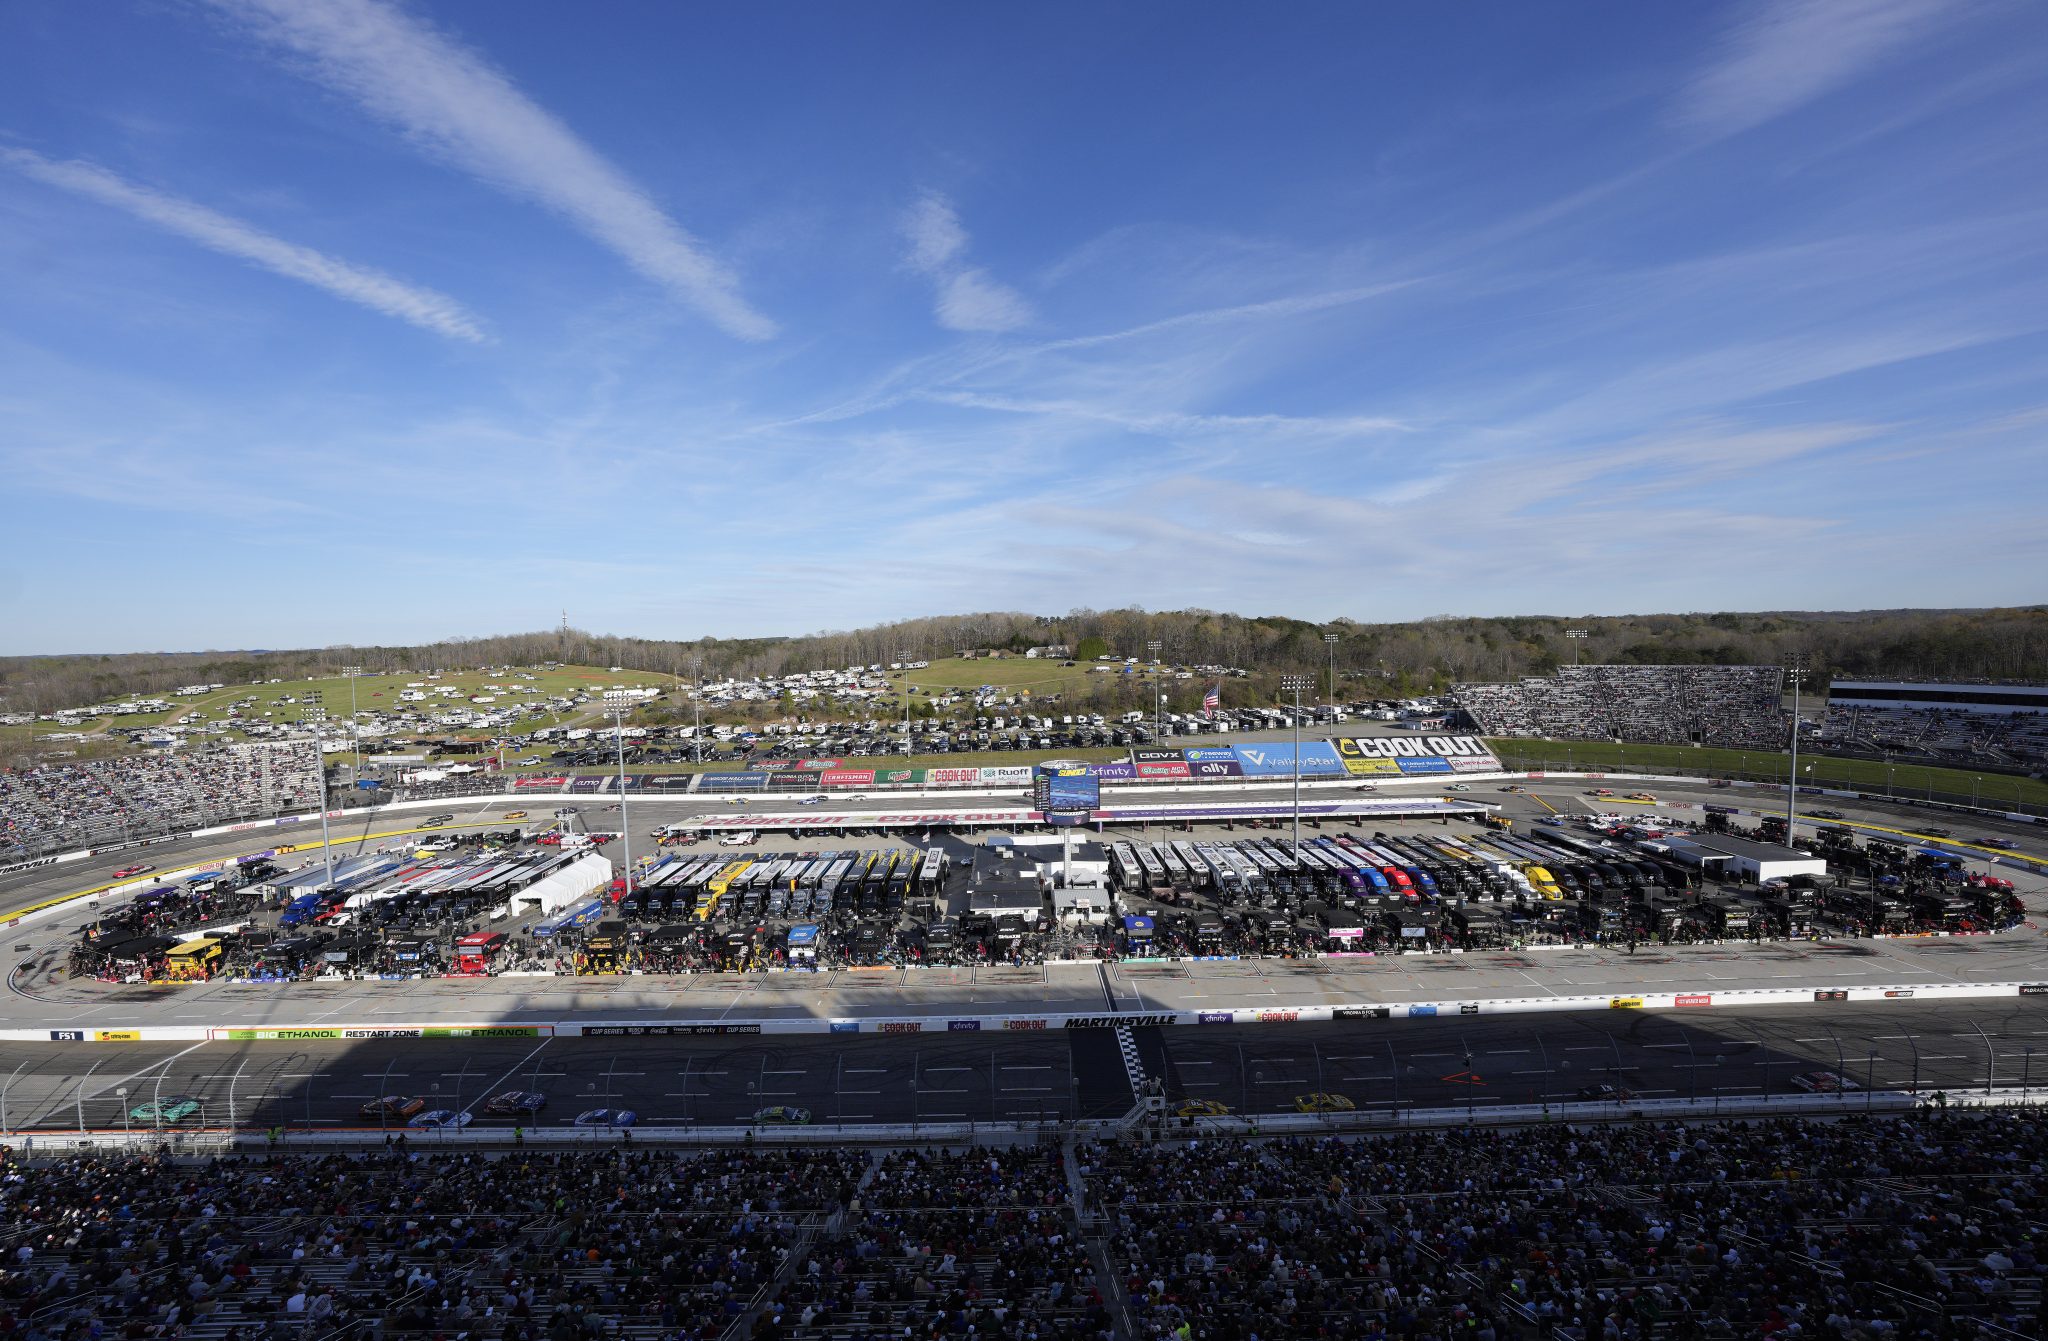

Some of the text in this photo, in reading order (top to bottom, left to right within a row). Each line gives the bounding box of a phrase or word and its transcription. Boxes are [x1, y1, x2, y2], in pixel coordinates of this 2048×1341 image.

[1355, 736, 1484, 758] COOK OUT
[1266, 757, 1335, 767] ValleyStar
[998, 768, 1029, 776] Ruoff
[1090, 766, 1131, 776] xfinity
[1201, 763, 1229, 775] ally
[1064, 1015, 1178, 1028] MARTINSVILLE
[1204, 1014, 1227, 1023] xfinity
[1261, 1012, 1299, 1022] COOK OUT
[884, 1022, 922, 1033] COOK OUT
[953, 1022, 975, 1031] xfinity
[1009, 1019, 1047, 1030] COOK OUT
[345, 1030, 391, 1038] RESTART
[696, 1026, 716, 1034] xfinity
[58, 1032, 75, 1040] FS1
